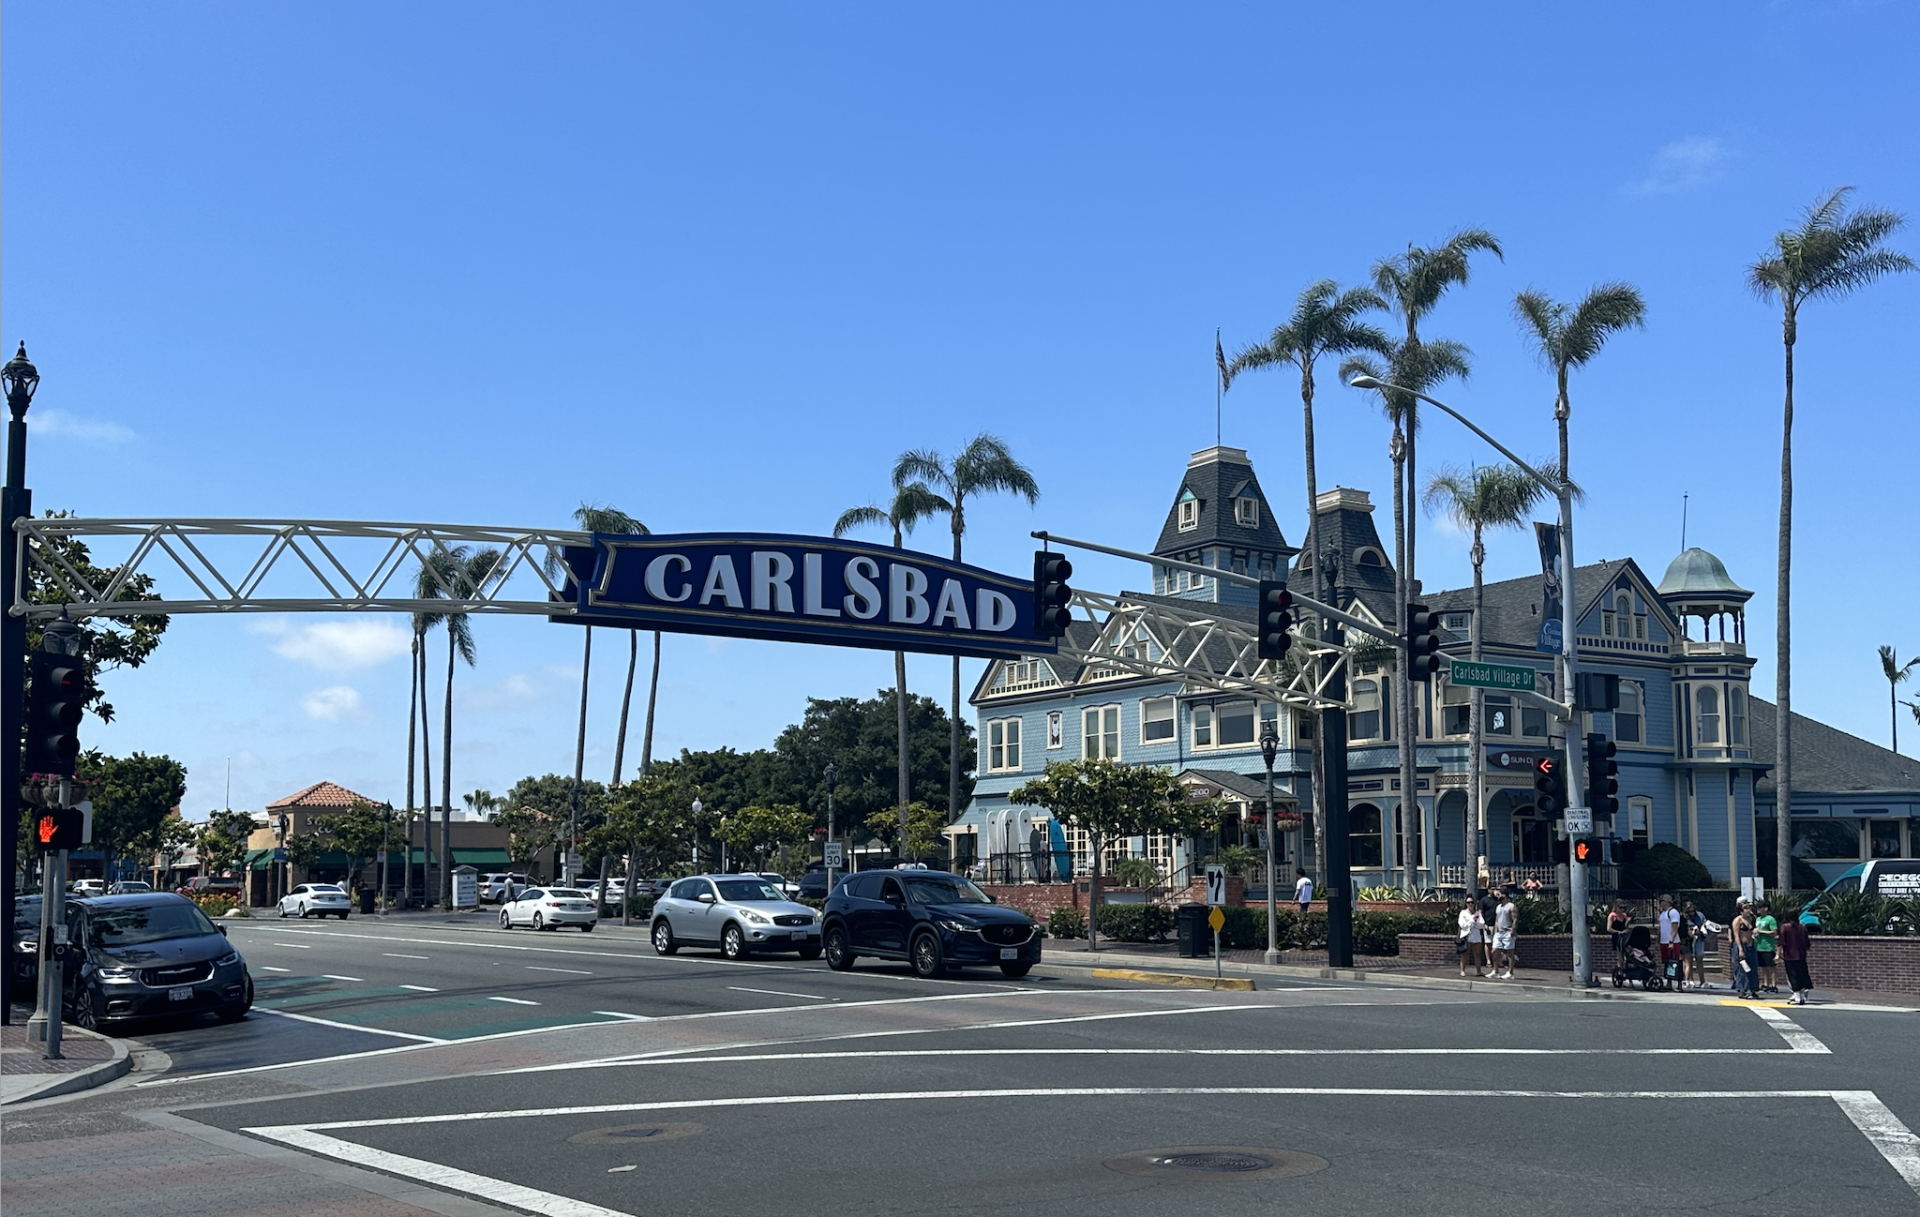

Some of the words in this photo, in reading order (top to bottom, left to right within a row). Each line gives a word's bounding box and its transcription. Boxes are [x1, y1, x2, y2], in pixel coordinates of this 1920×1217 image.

[644, 551, 1017, 632] CARLSBAD
[1541, 634, 1561, 650] Village
[1454, 665, 1490, 682] Carlsbad
[1493, 668, 1521, 687] Village
[1523, 671, 1533, 685] Dr
[1510, 756, 1526, 764] SUN
[1567, 821, 1580, 832] OK
[826, 855, 841, 865] 30
